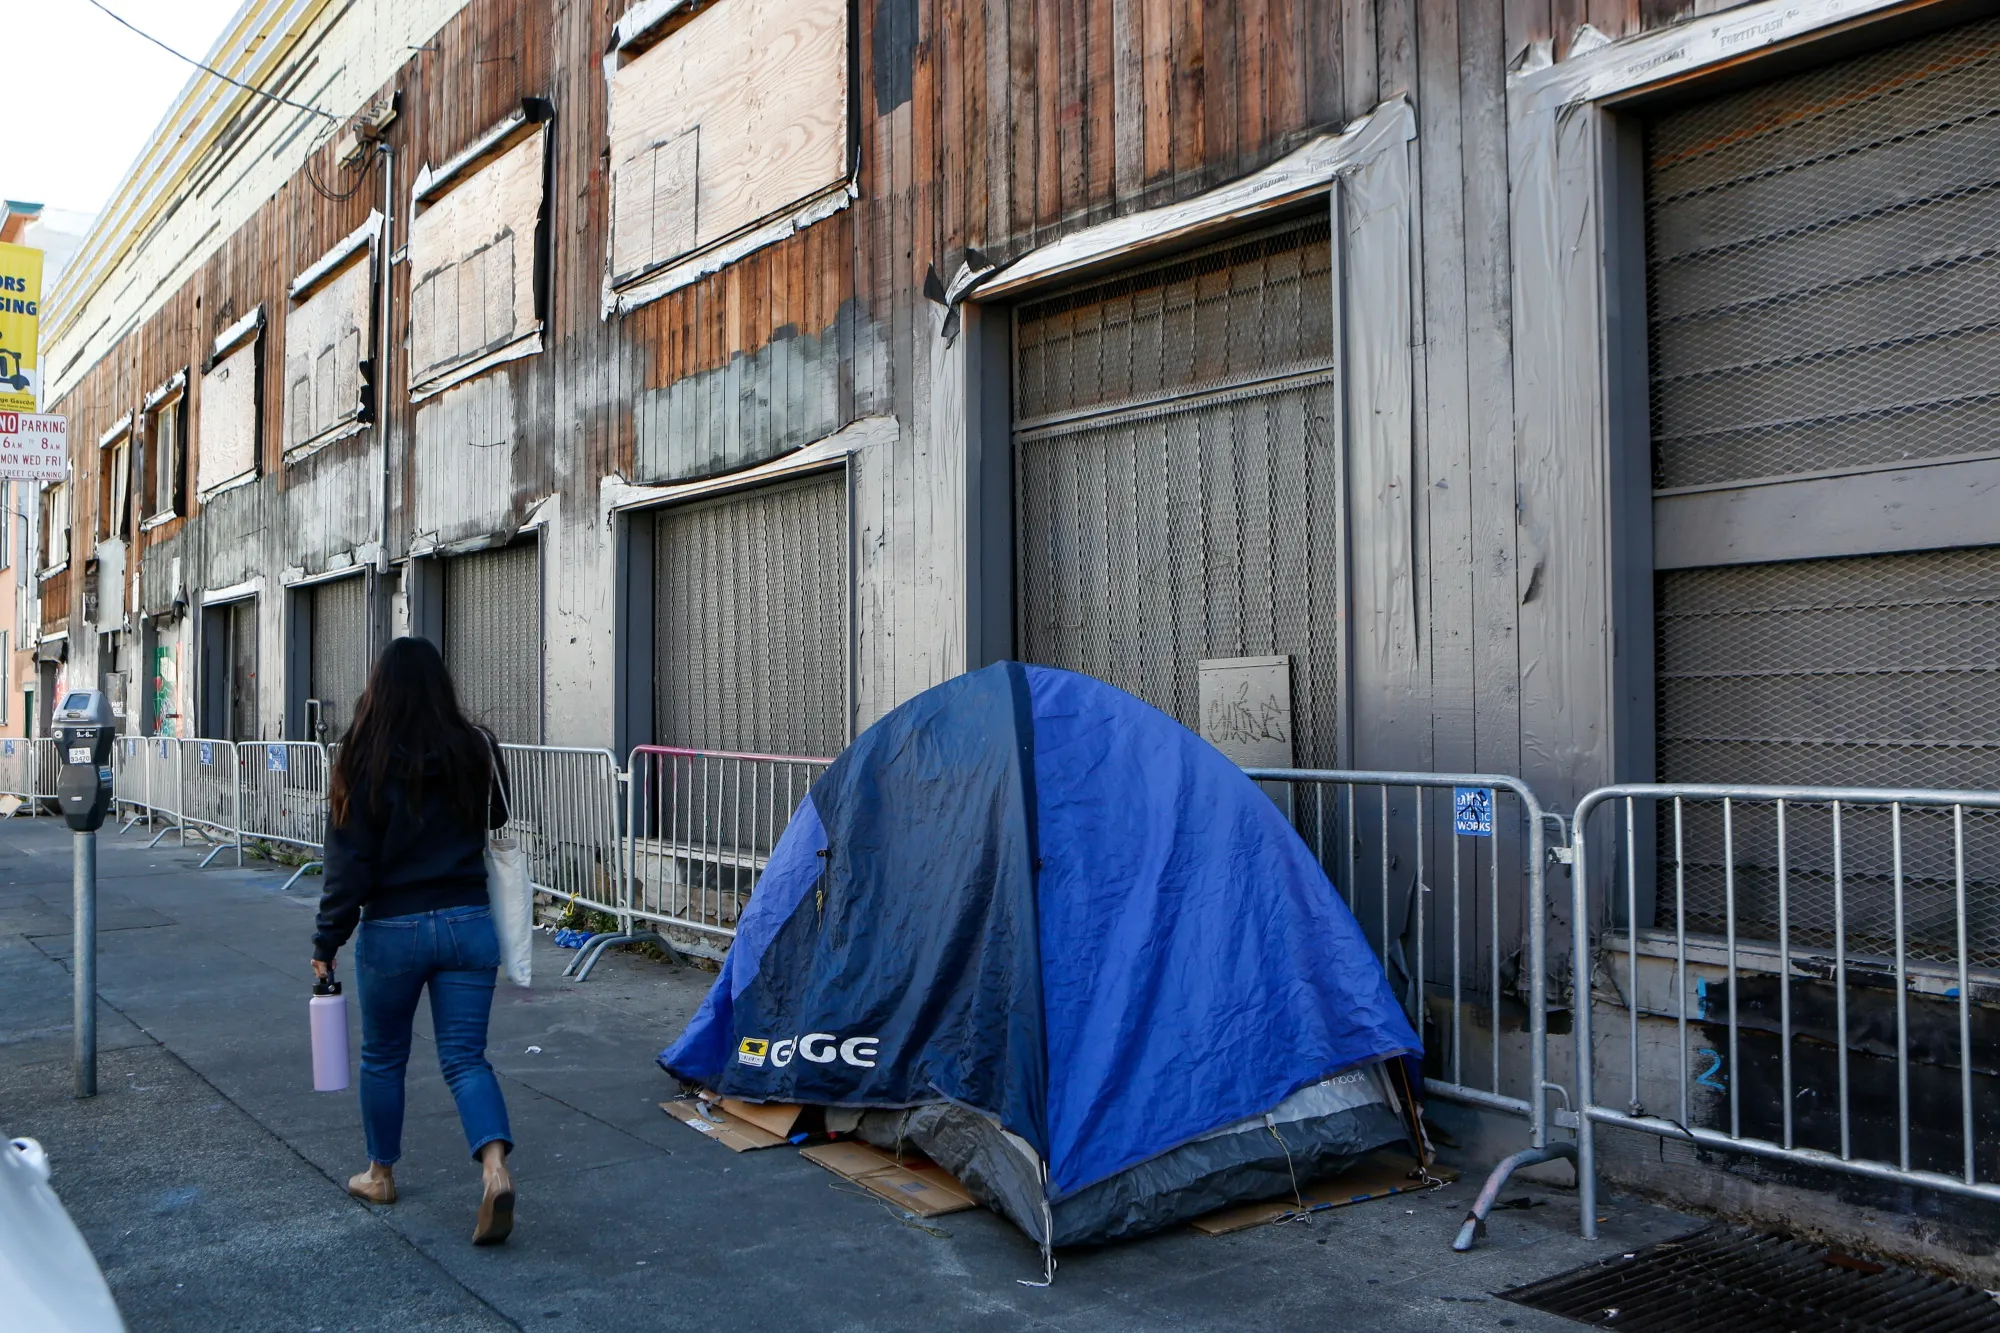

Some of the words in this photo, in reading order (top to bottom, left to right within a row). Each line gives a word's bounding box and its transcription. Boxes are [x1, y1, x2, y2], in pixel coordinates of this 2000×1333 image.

[0, 415, 17, 433] NO
[22, 419, 65, 434] PARKING
[0, 453, 19, 465] MON
[22, 454, 41, 466] WED
[45, 455, 61, 467] FRI
[0, 469, 24, 477] STREET
[28, 470, 63, 479] CLEANING
[1456, 810, 1491, 821] PUBIC
[1457, 821, 1491, 832] WORKS
